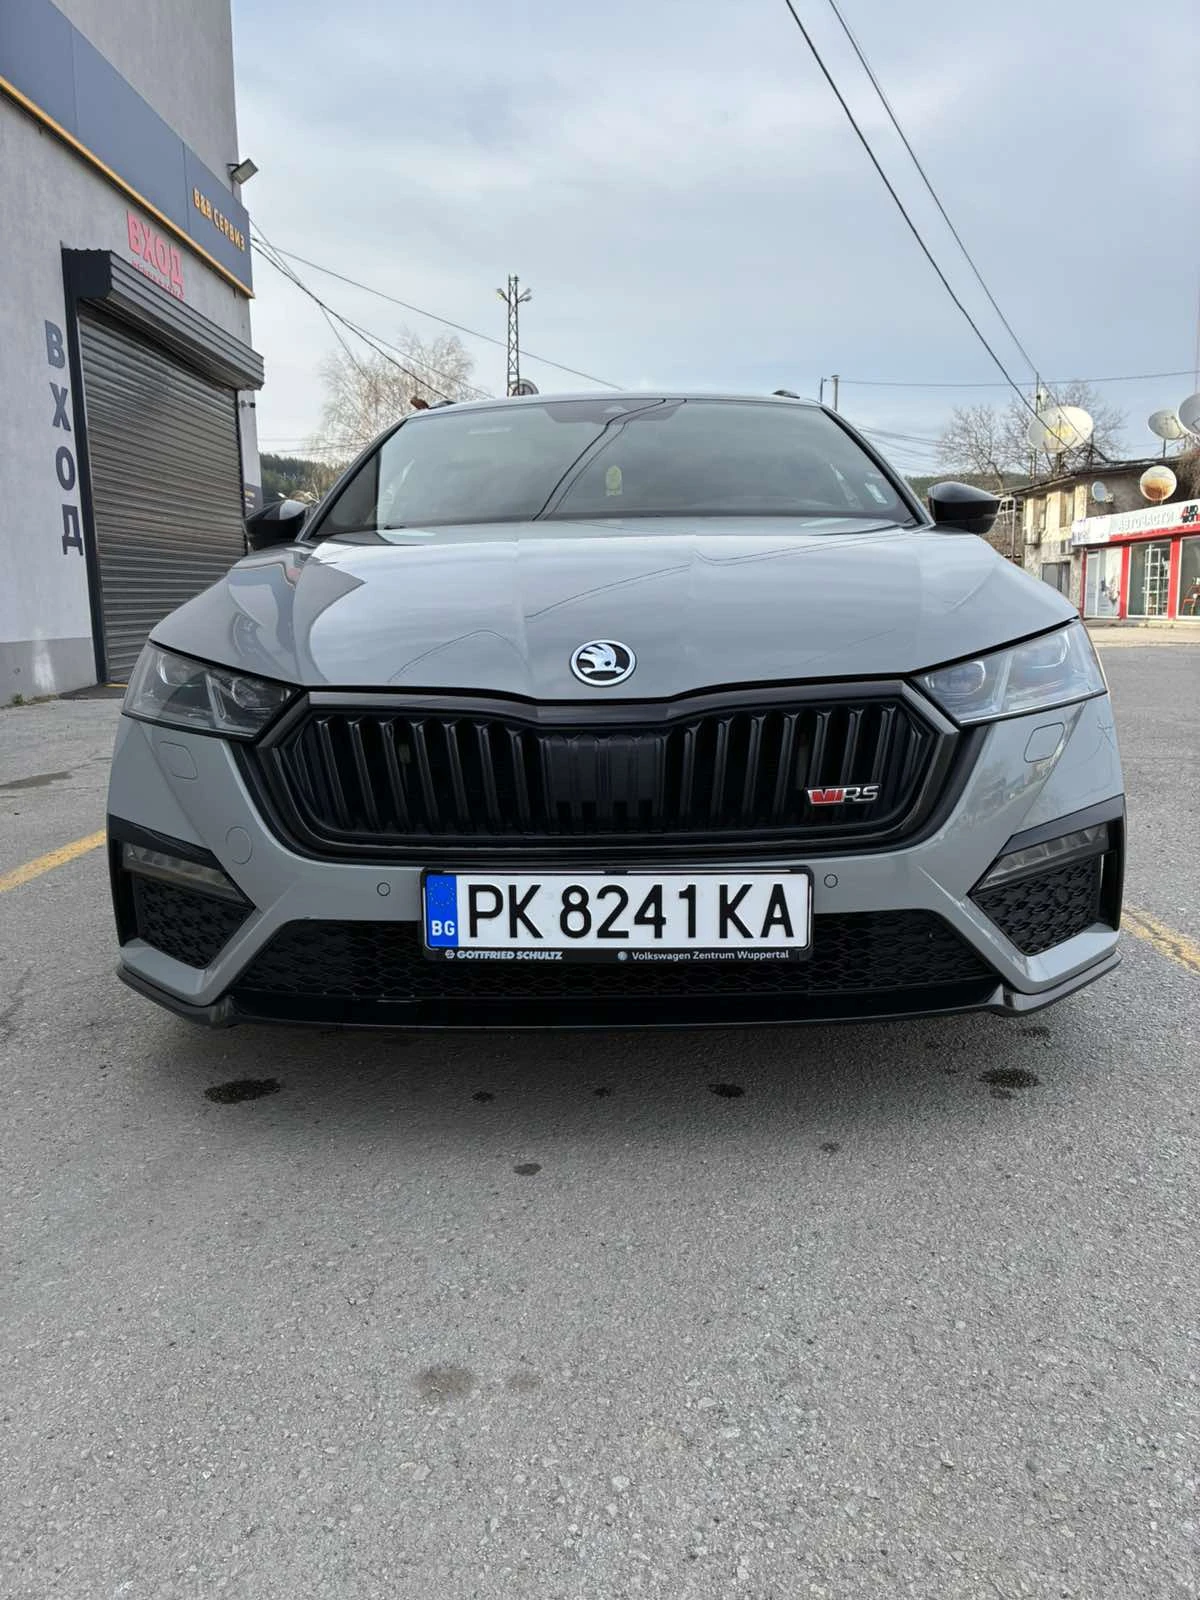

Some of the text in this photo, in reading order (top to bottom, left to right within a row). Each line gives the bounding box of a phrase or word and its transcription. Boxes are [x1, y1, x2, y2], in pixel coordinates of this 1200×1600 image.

[127, 209, 184, 298] ВХОД
[45, 319, 84, 556] ВХОД
[431, 920, 455, 937] BG
[468, 883, 795, 939] PK 8241 KA
[457, 951, 563, 960] GOTTFRIED SCHULTZ
[631, 950, 789, 962] Volkswagen Zentrum Wuppertal
